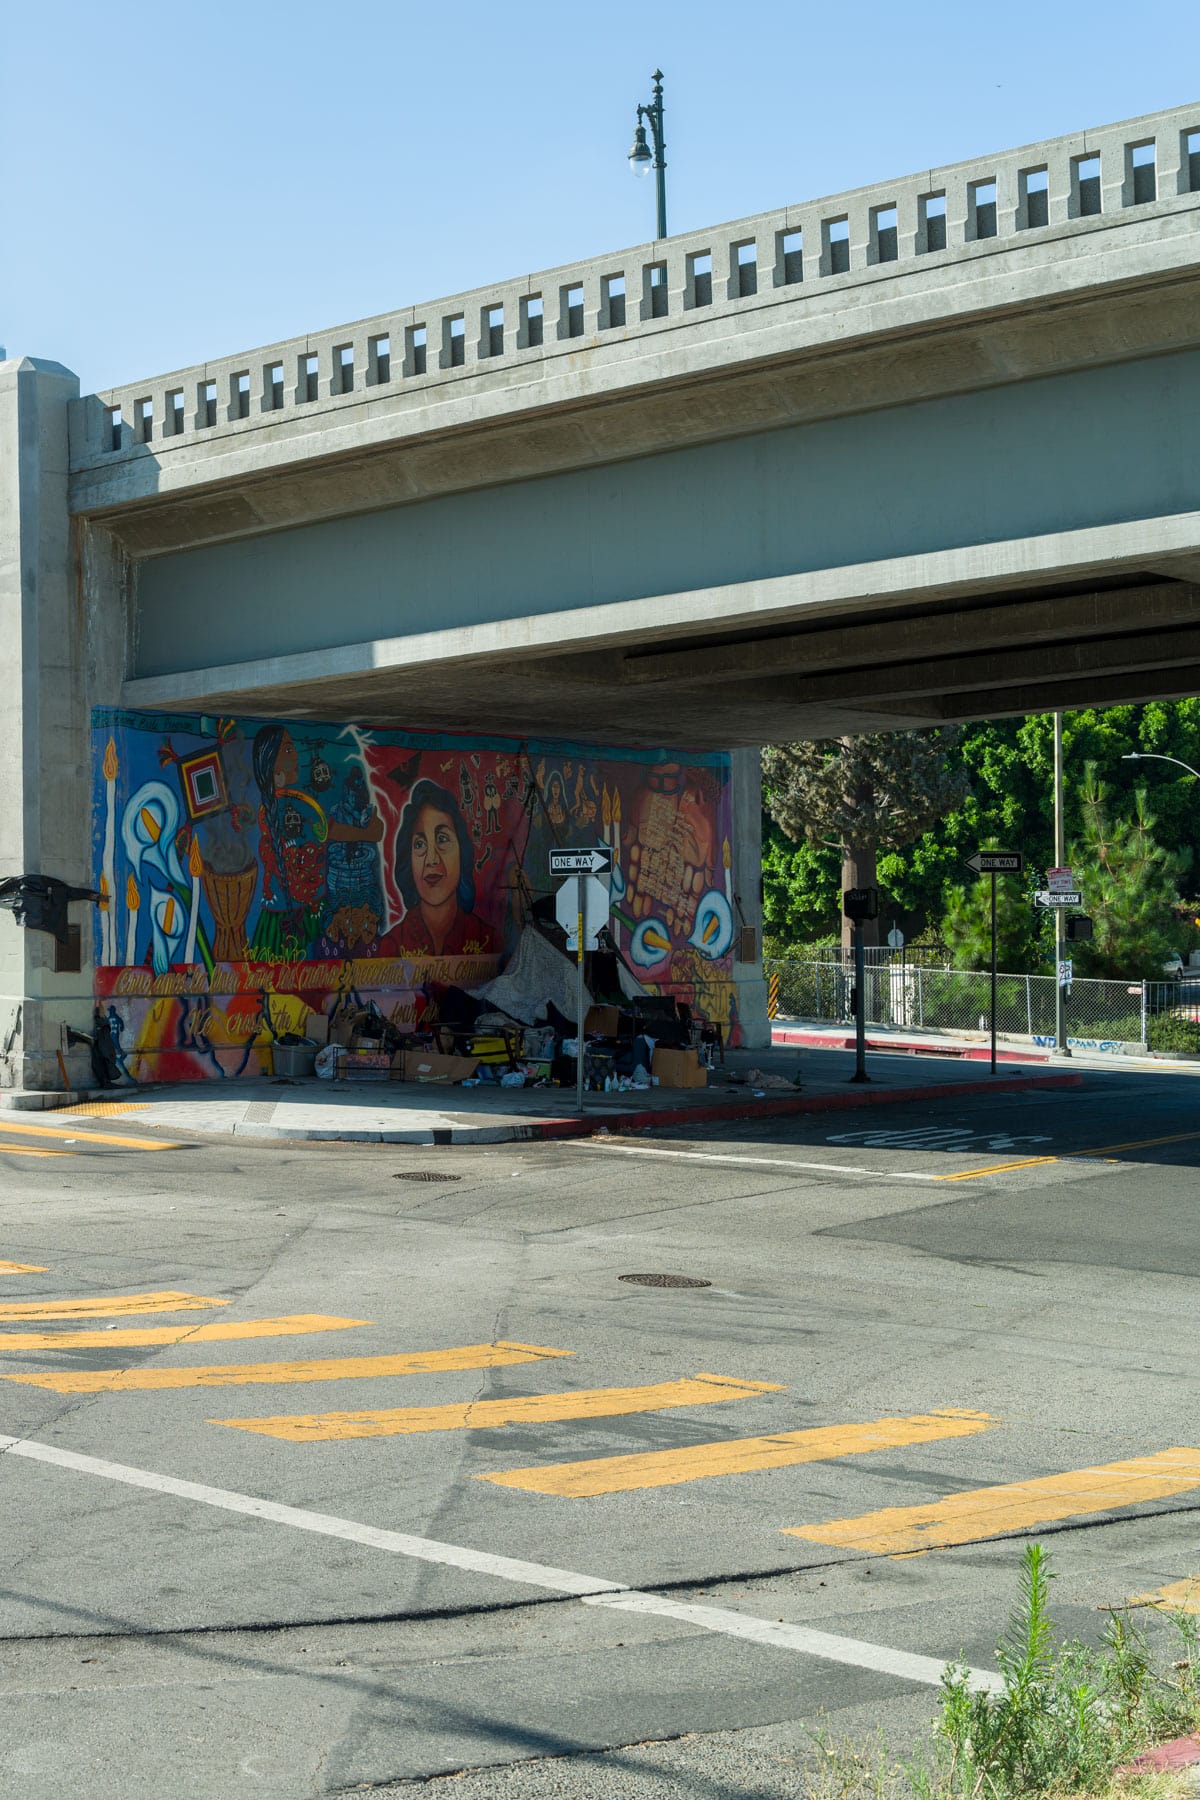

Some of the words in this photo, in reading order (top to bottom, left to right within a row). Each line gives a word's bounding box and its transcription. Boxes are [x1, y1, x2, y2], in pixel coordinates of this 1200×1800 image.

[554, 858, 571, 867] ONE
[575, 856, 595, 867] WAY
[980, 858, 997, 867] ONE
[998, 858, 1015, 867] WAY
